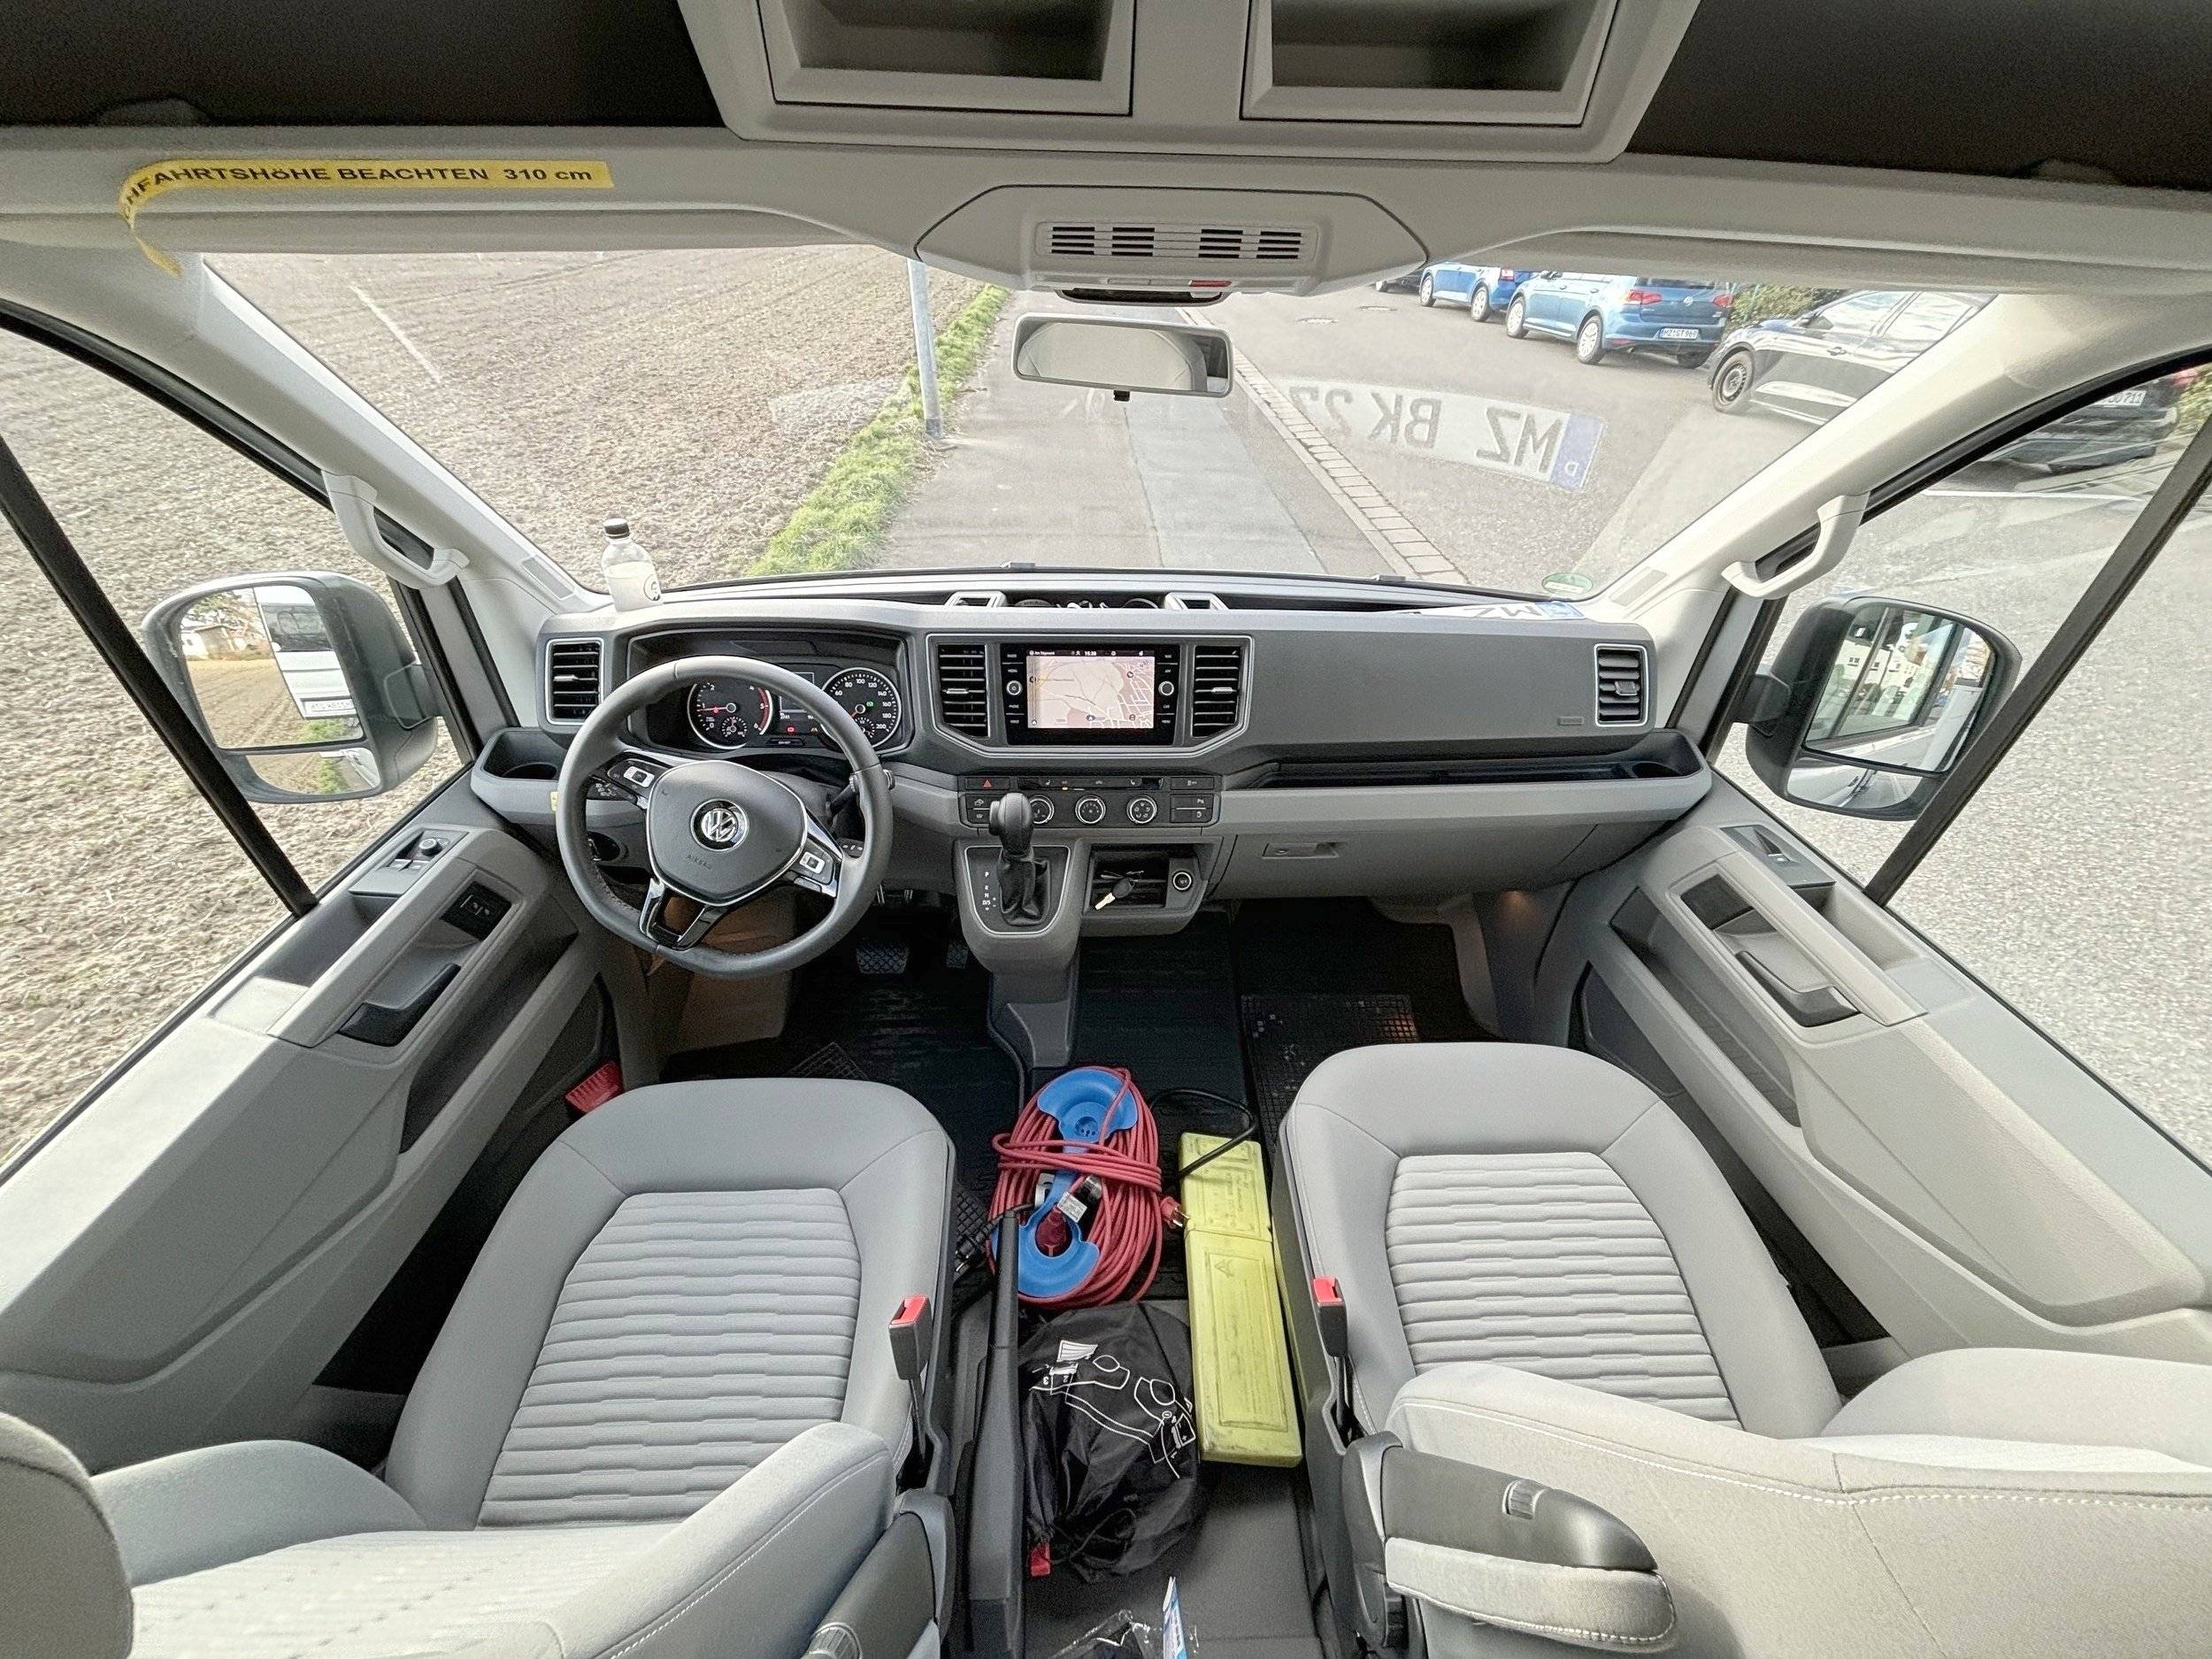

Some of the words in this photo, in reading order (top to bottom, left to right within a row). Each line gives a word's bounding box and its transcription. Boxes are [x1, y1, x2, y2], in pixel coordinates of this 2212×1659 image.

[337, 168, 489, 180] BEACHTEN
[503, 168, 547, 180] 310
[555, 171, 593, 180] cm
